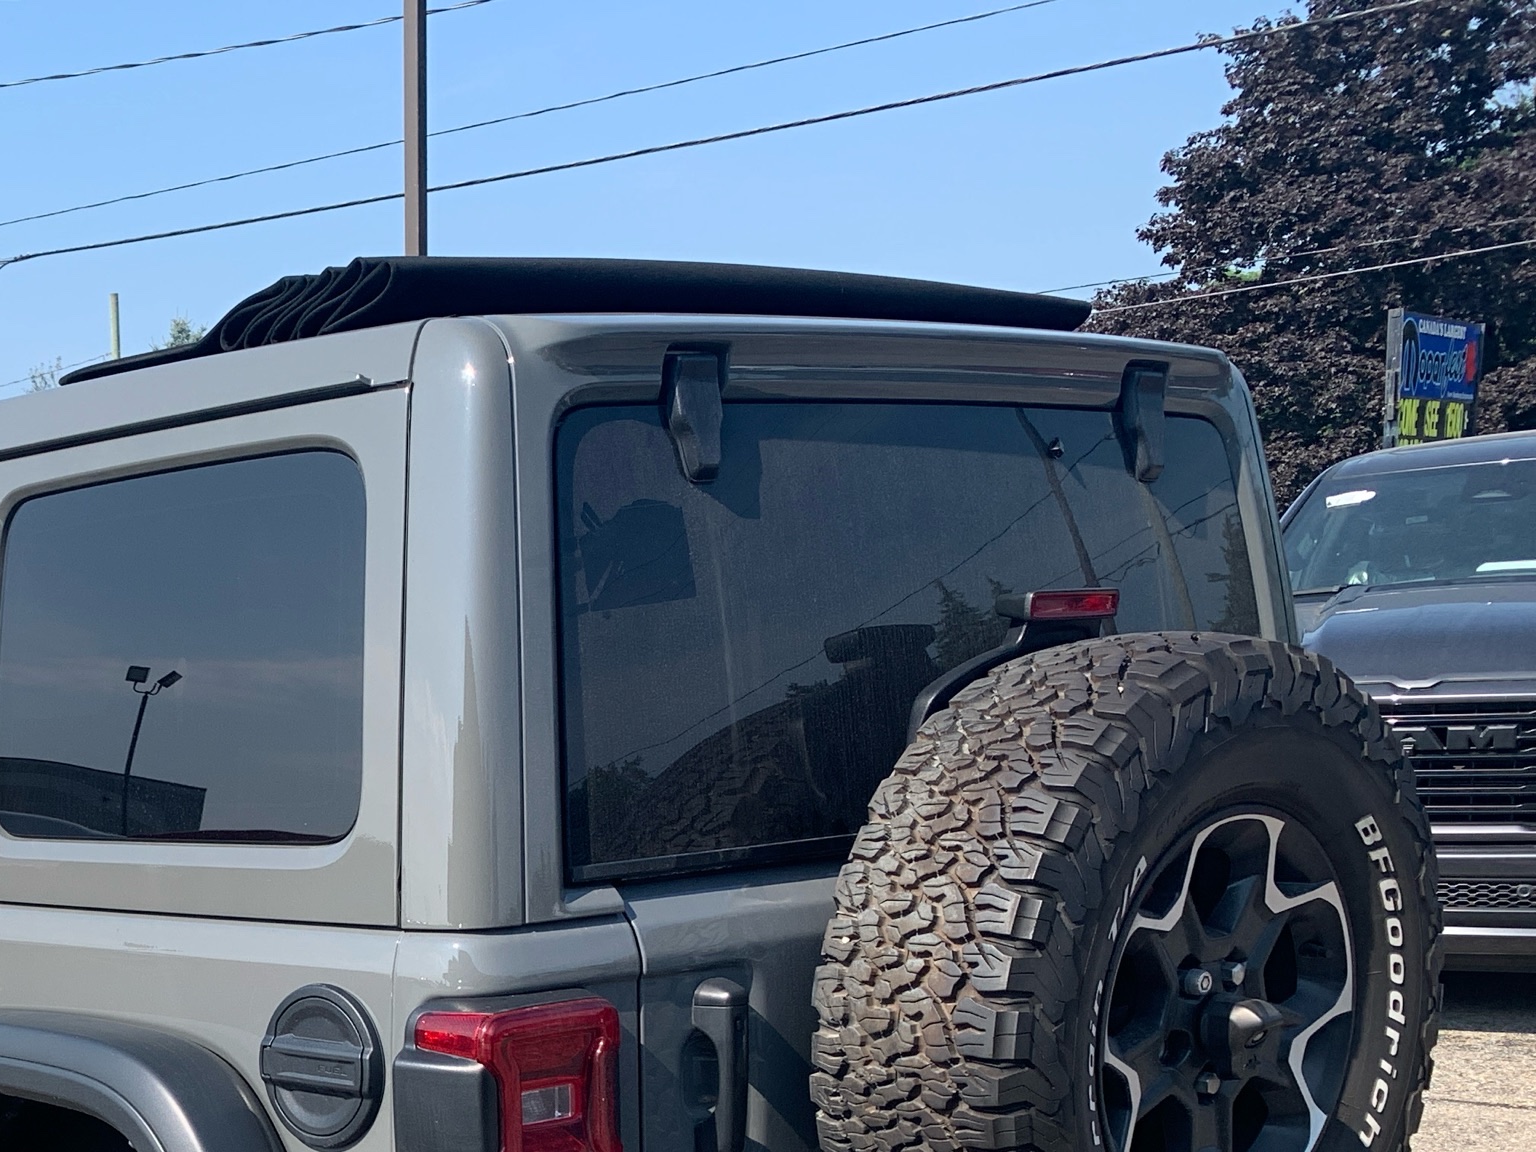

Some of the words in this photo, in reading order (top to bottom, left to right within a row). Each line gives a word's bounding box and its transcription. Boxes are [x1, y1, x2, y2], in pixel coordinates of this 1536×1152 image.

[1424, 400, 1441, 437] SEE
[1391, 725, 1518, 750] AM
[1354, 814, 1407, 1149] BFGoodrich
[317, 1064, 348, 1077] FUEL
